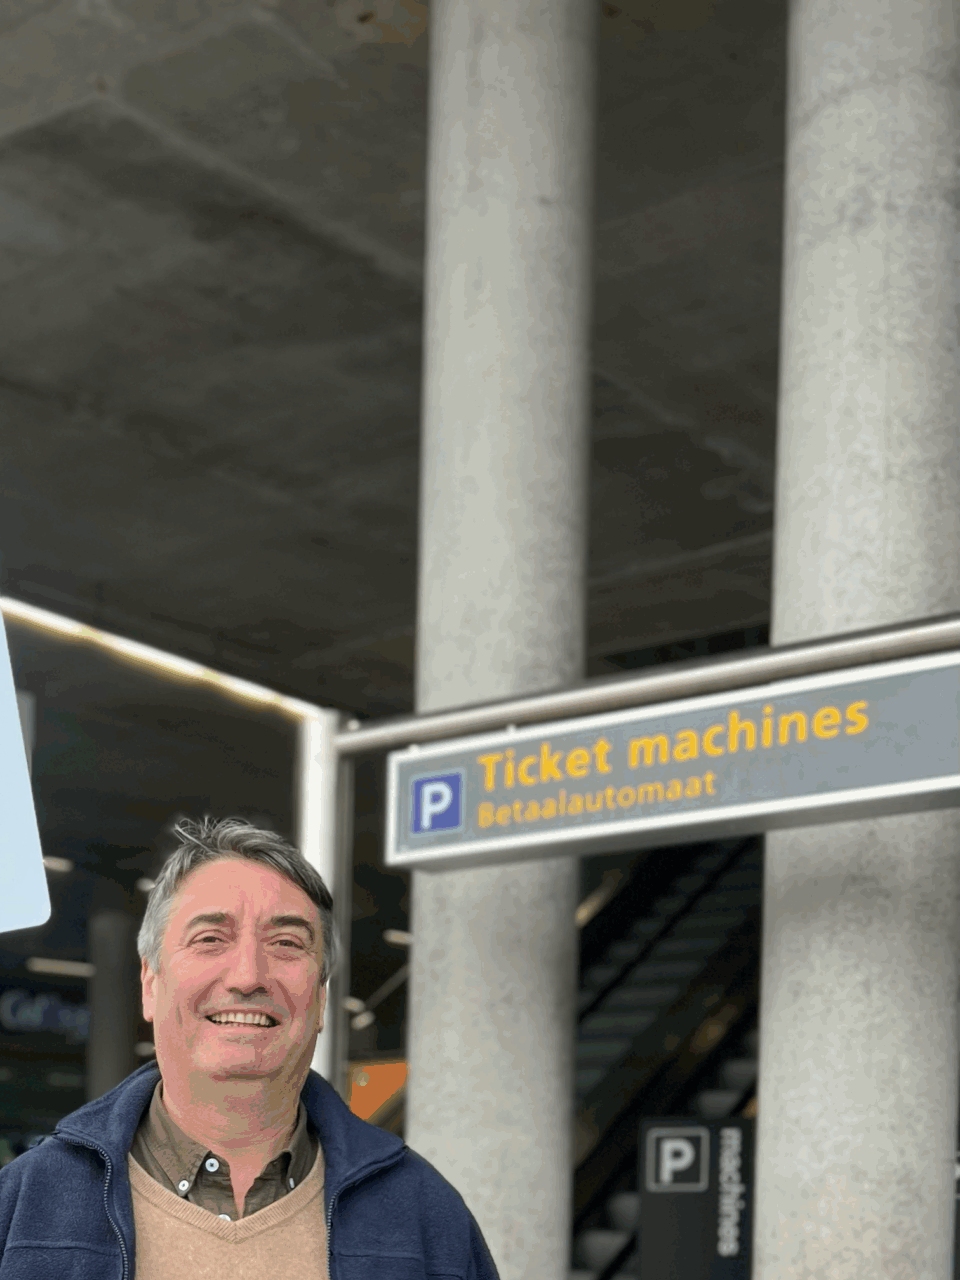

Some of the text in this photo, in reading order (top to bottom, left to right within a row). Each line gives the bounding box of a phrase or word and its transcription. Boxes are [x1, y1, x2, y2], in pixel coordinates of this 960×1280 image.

[477, 700, 869, 792] Ticket machines
[421, 781, 453, 830] P
[477, 771, 716, 829] Betaalautomaat
[660, 1137, 696, 1185] P
